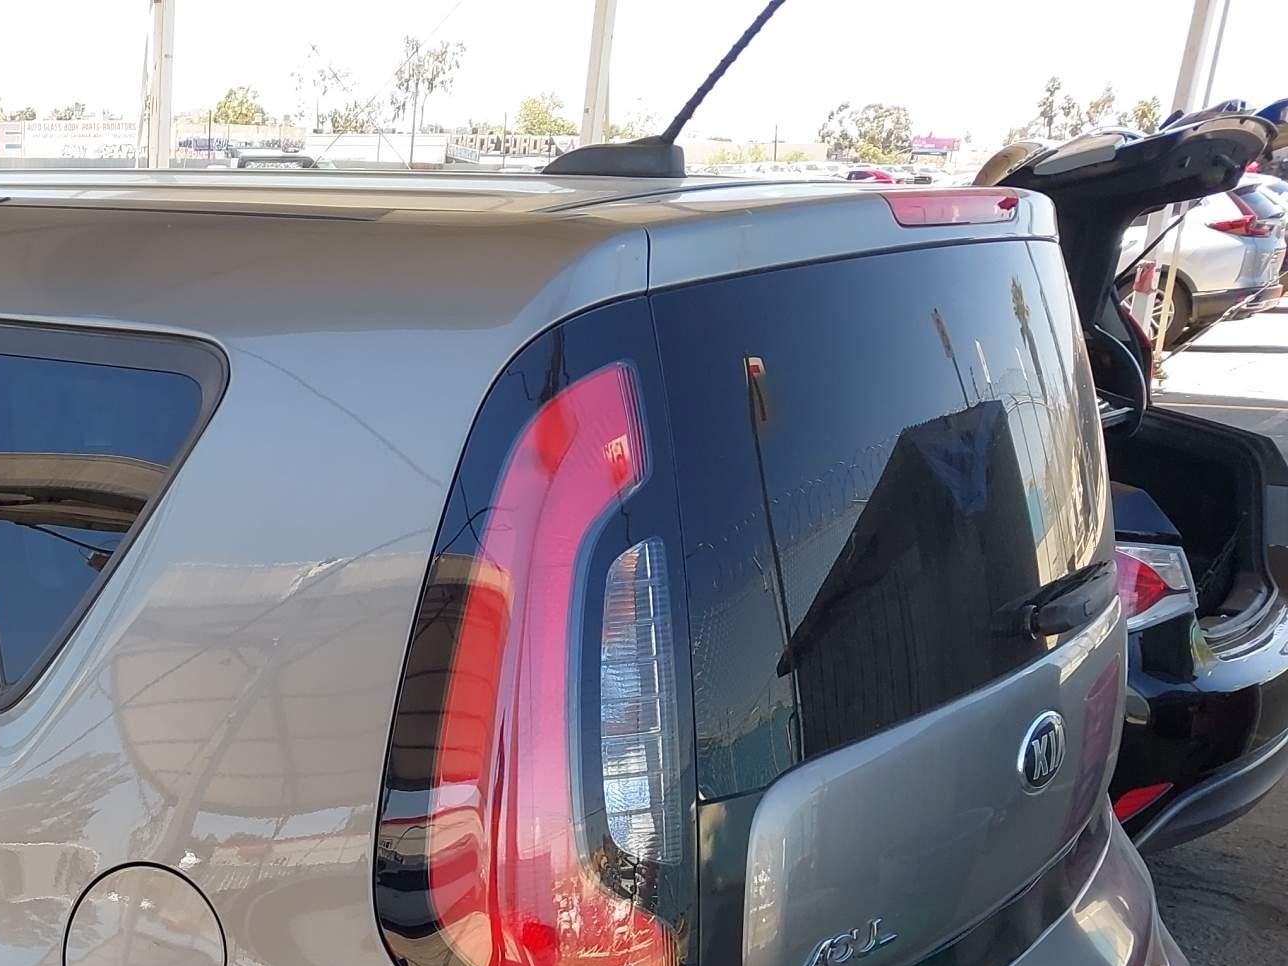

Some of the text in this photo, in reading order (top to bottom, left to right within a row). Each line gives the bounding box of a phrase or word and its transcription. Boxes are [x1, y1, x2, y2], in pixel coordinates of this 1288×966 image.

[43, 122, 62, 131] GLASS
[81, 122, 100, 131] PARTS
[102, 121, 137, 131] RADIATORS
